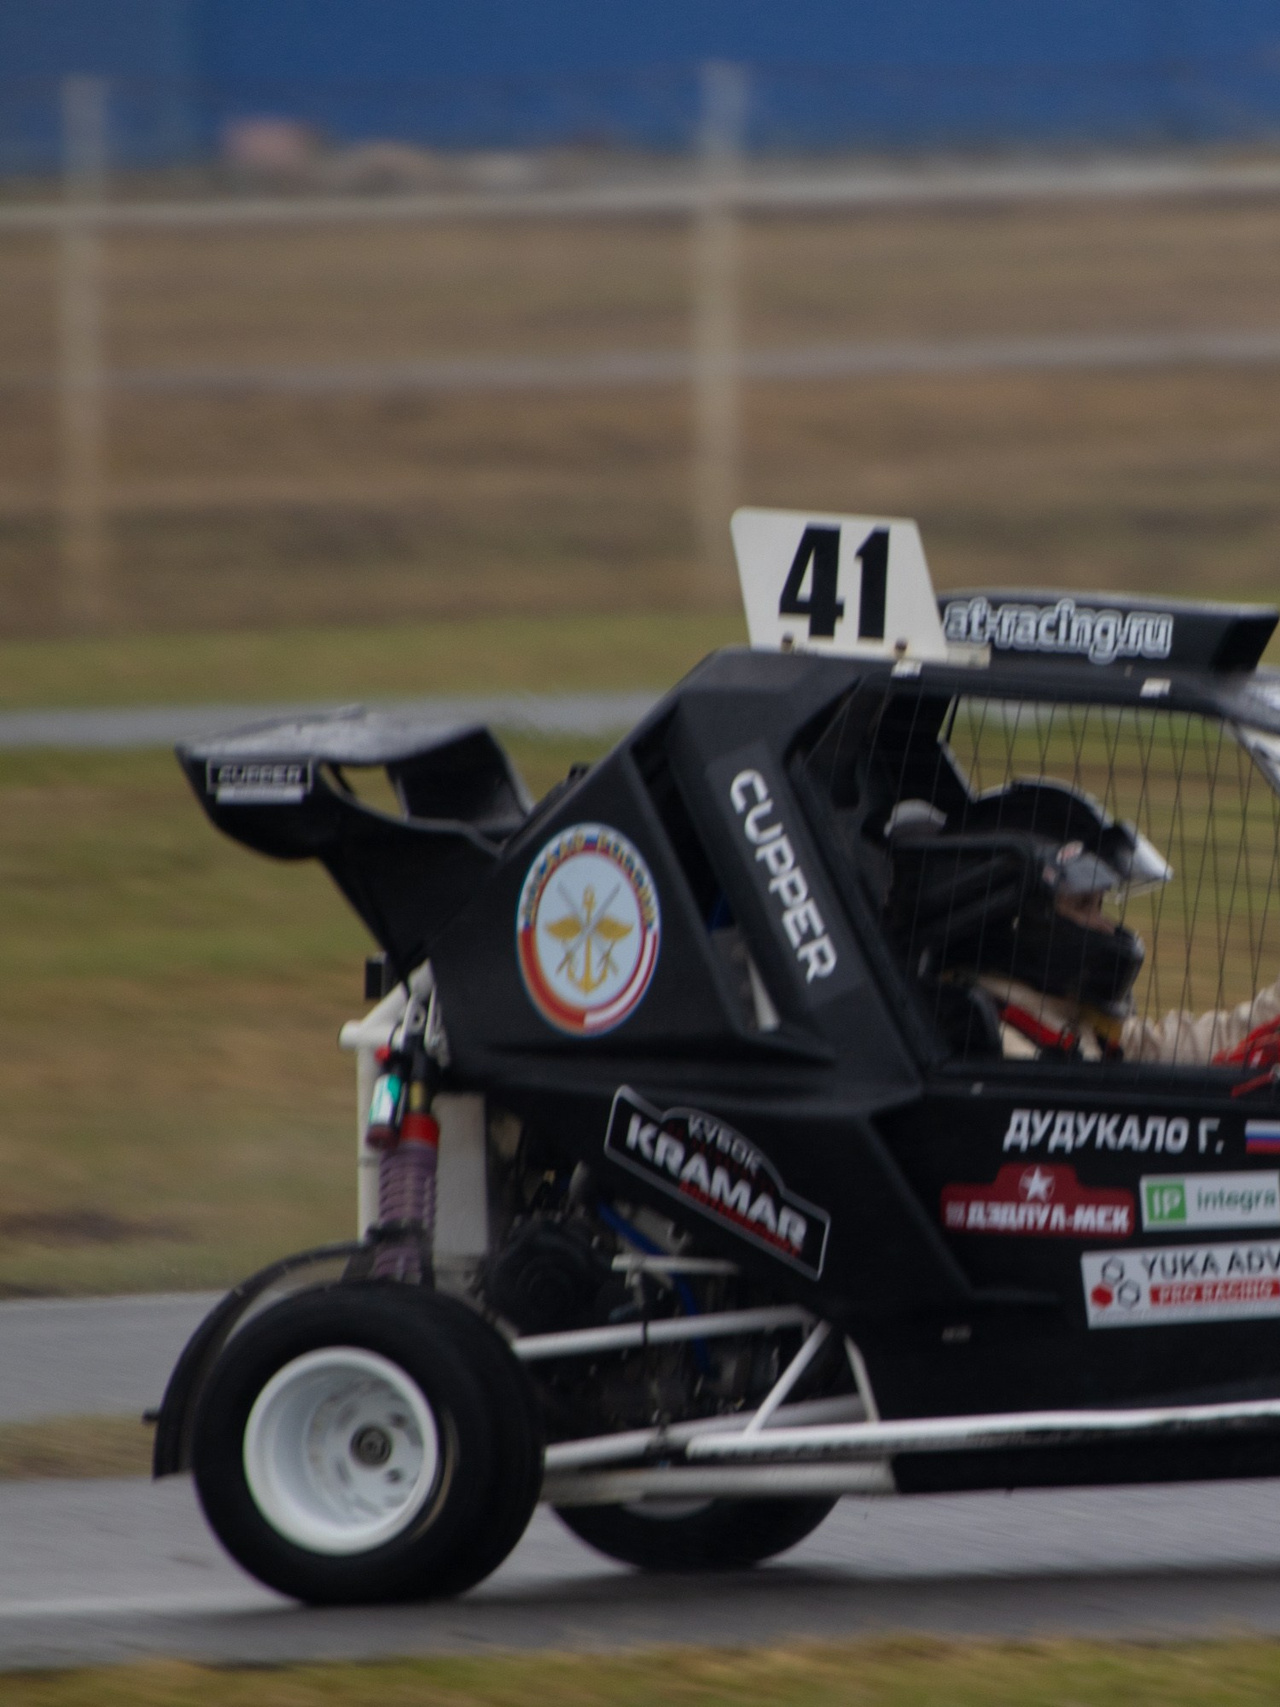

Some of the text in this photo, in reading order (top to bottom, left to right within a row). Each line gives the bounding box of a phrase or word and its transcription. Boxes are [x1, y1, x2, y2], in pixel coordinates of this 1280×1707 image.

[779, 522, 891, 642] 41
[730, 768, 838, 984] CUPPER
[1002, 1108, 1225, 1155] ДУДУКАЛО Г.
[625, 1112, 807, 1250] KRAMAR
[1197, 1186, 1277, 1213] integra
[1141, 1251, 1220, 1279] YUKA
